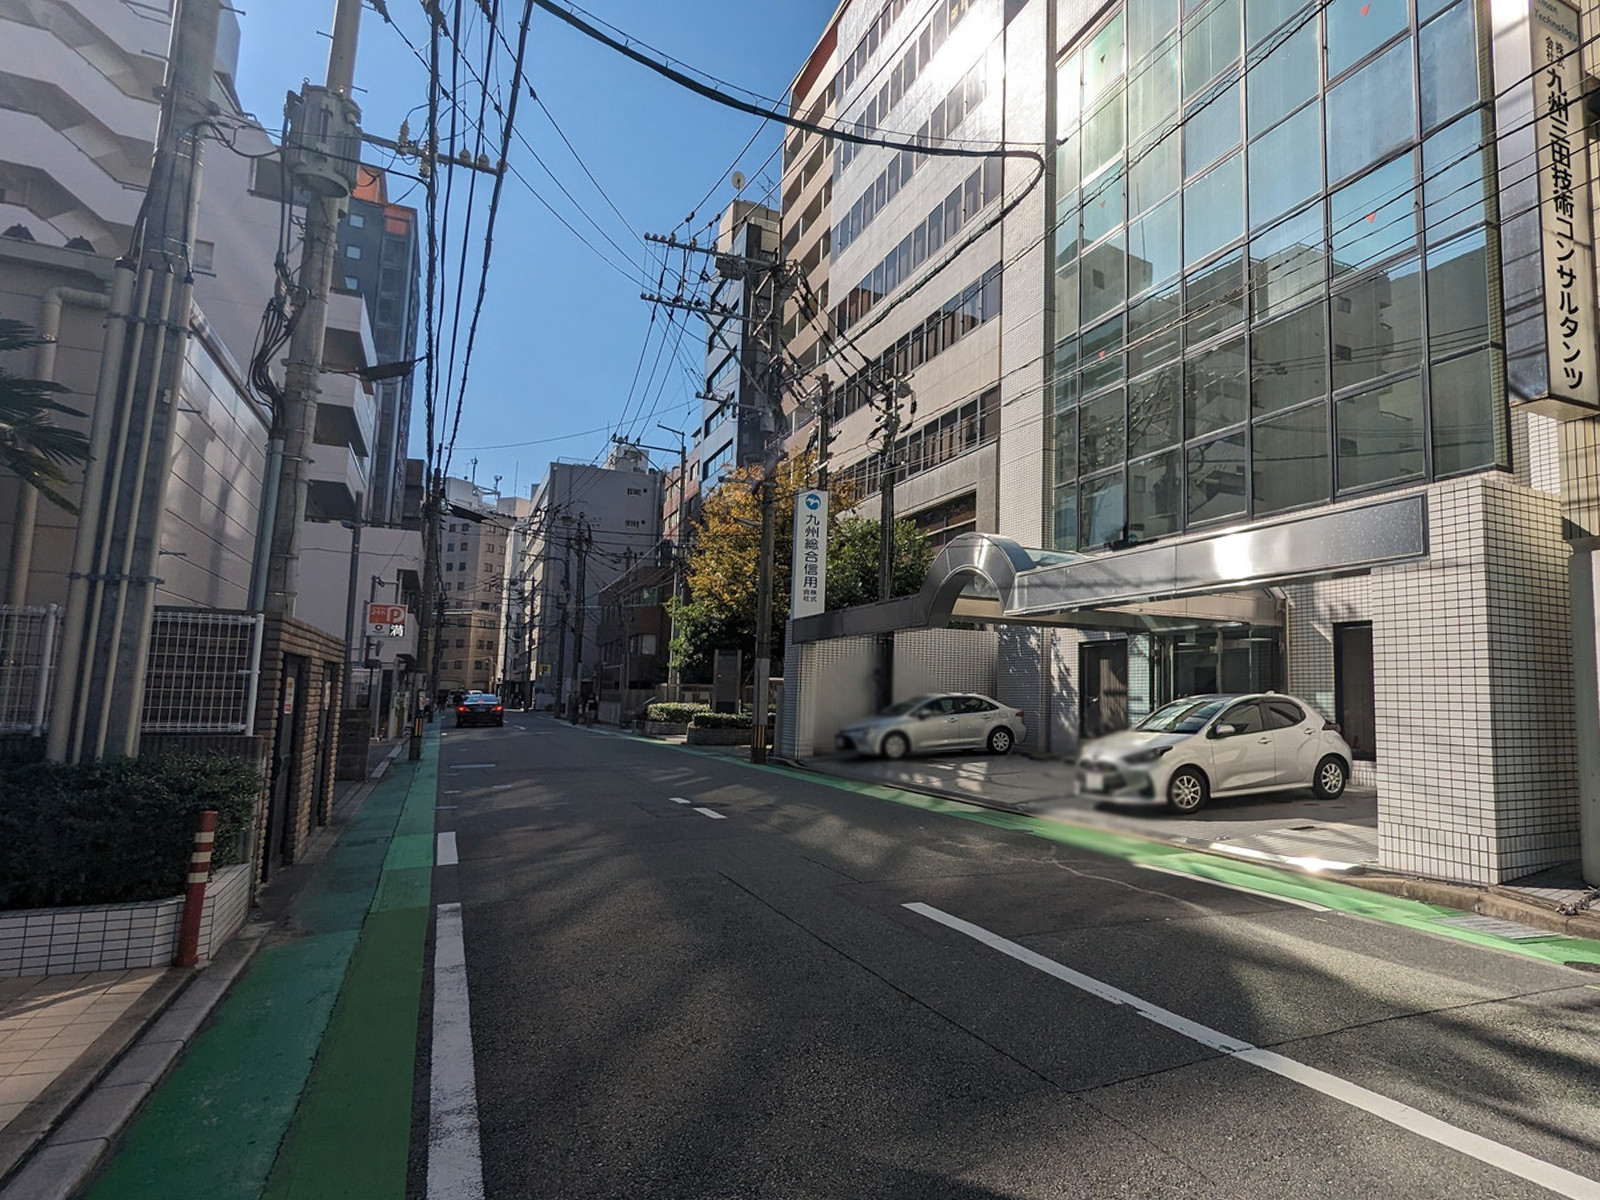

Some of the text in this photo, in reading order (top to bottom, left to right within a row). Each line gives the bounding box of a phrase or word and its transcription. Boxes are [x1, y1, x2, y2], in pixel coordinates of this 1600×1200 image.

[1534, 8, 1579, 42] Technology
[803, 514, 820, 588] 九州総合信用
[390, 624, 404, 637] 満
